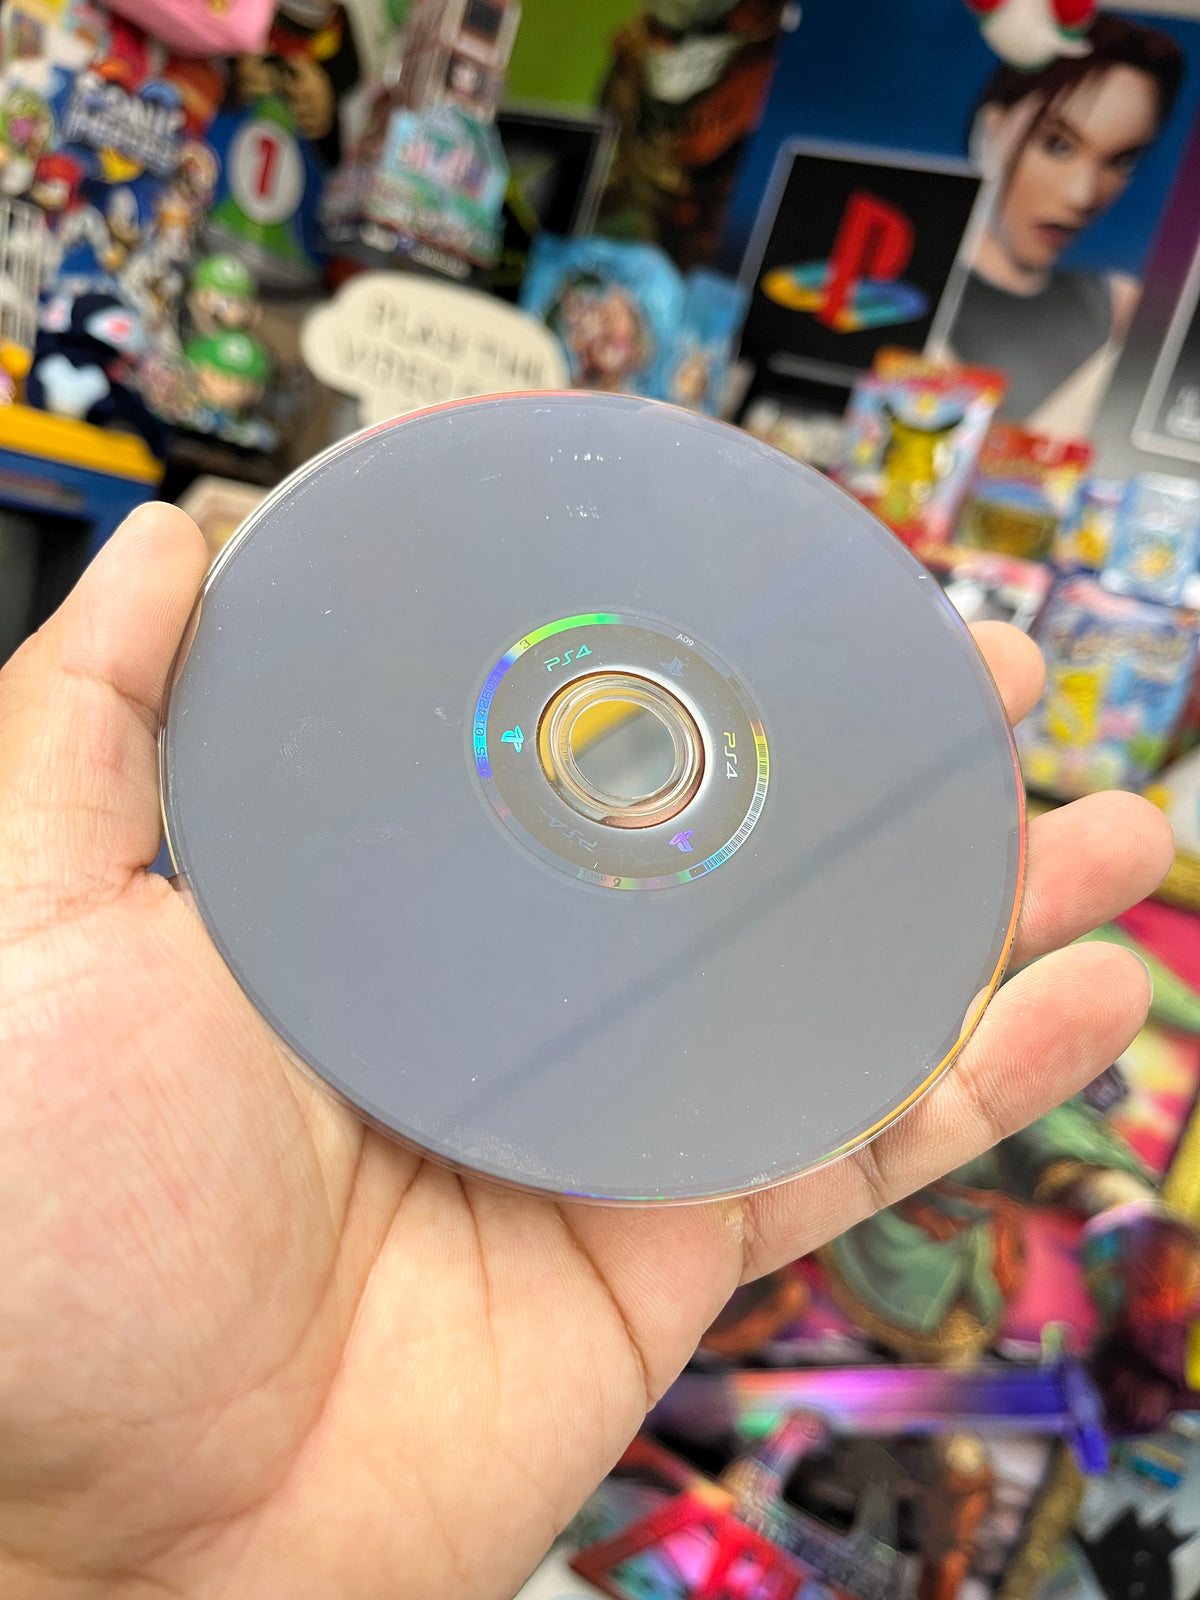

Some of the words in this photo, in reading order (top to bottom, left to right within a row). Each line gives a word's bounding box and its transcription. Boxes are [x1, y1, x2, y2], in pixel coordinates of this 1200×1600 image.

[676, 633, 695, 647] A09
[543, 644, 592, 672] PS4
[723, 731, 738, 779] PS4
